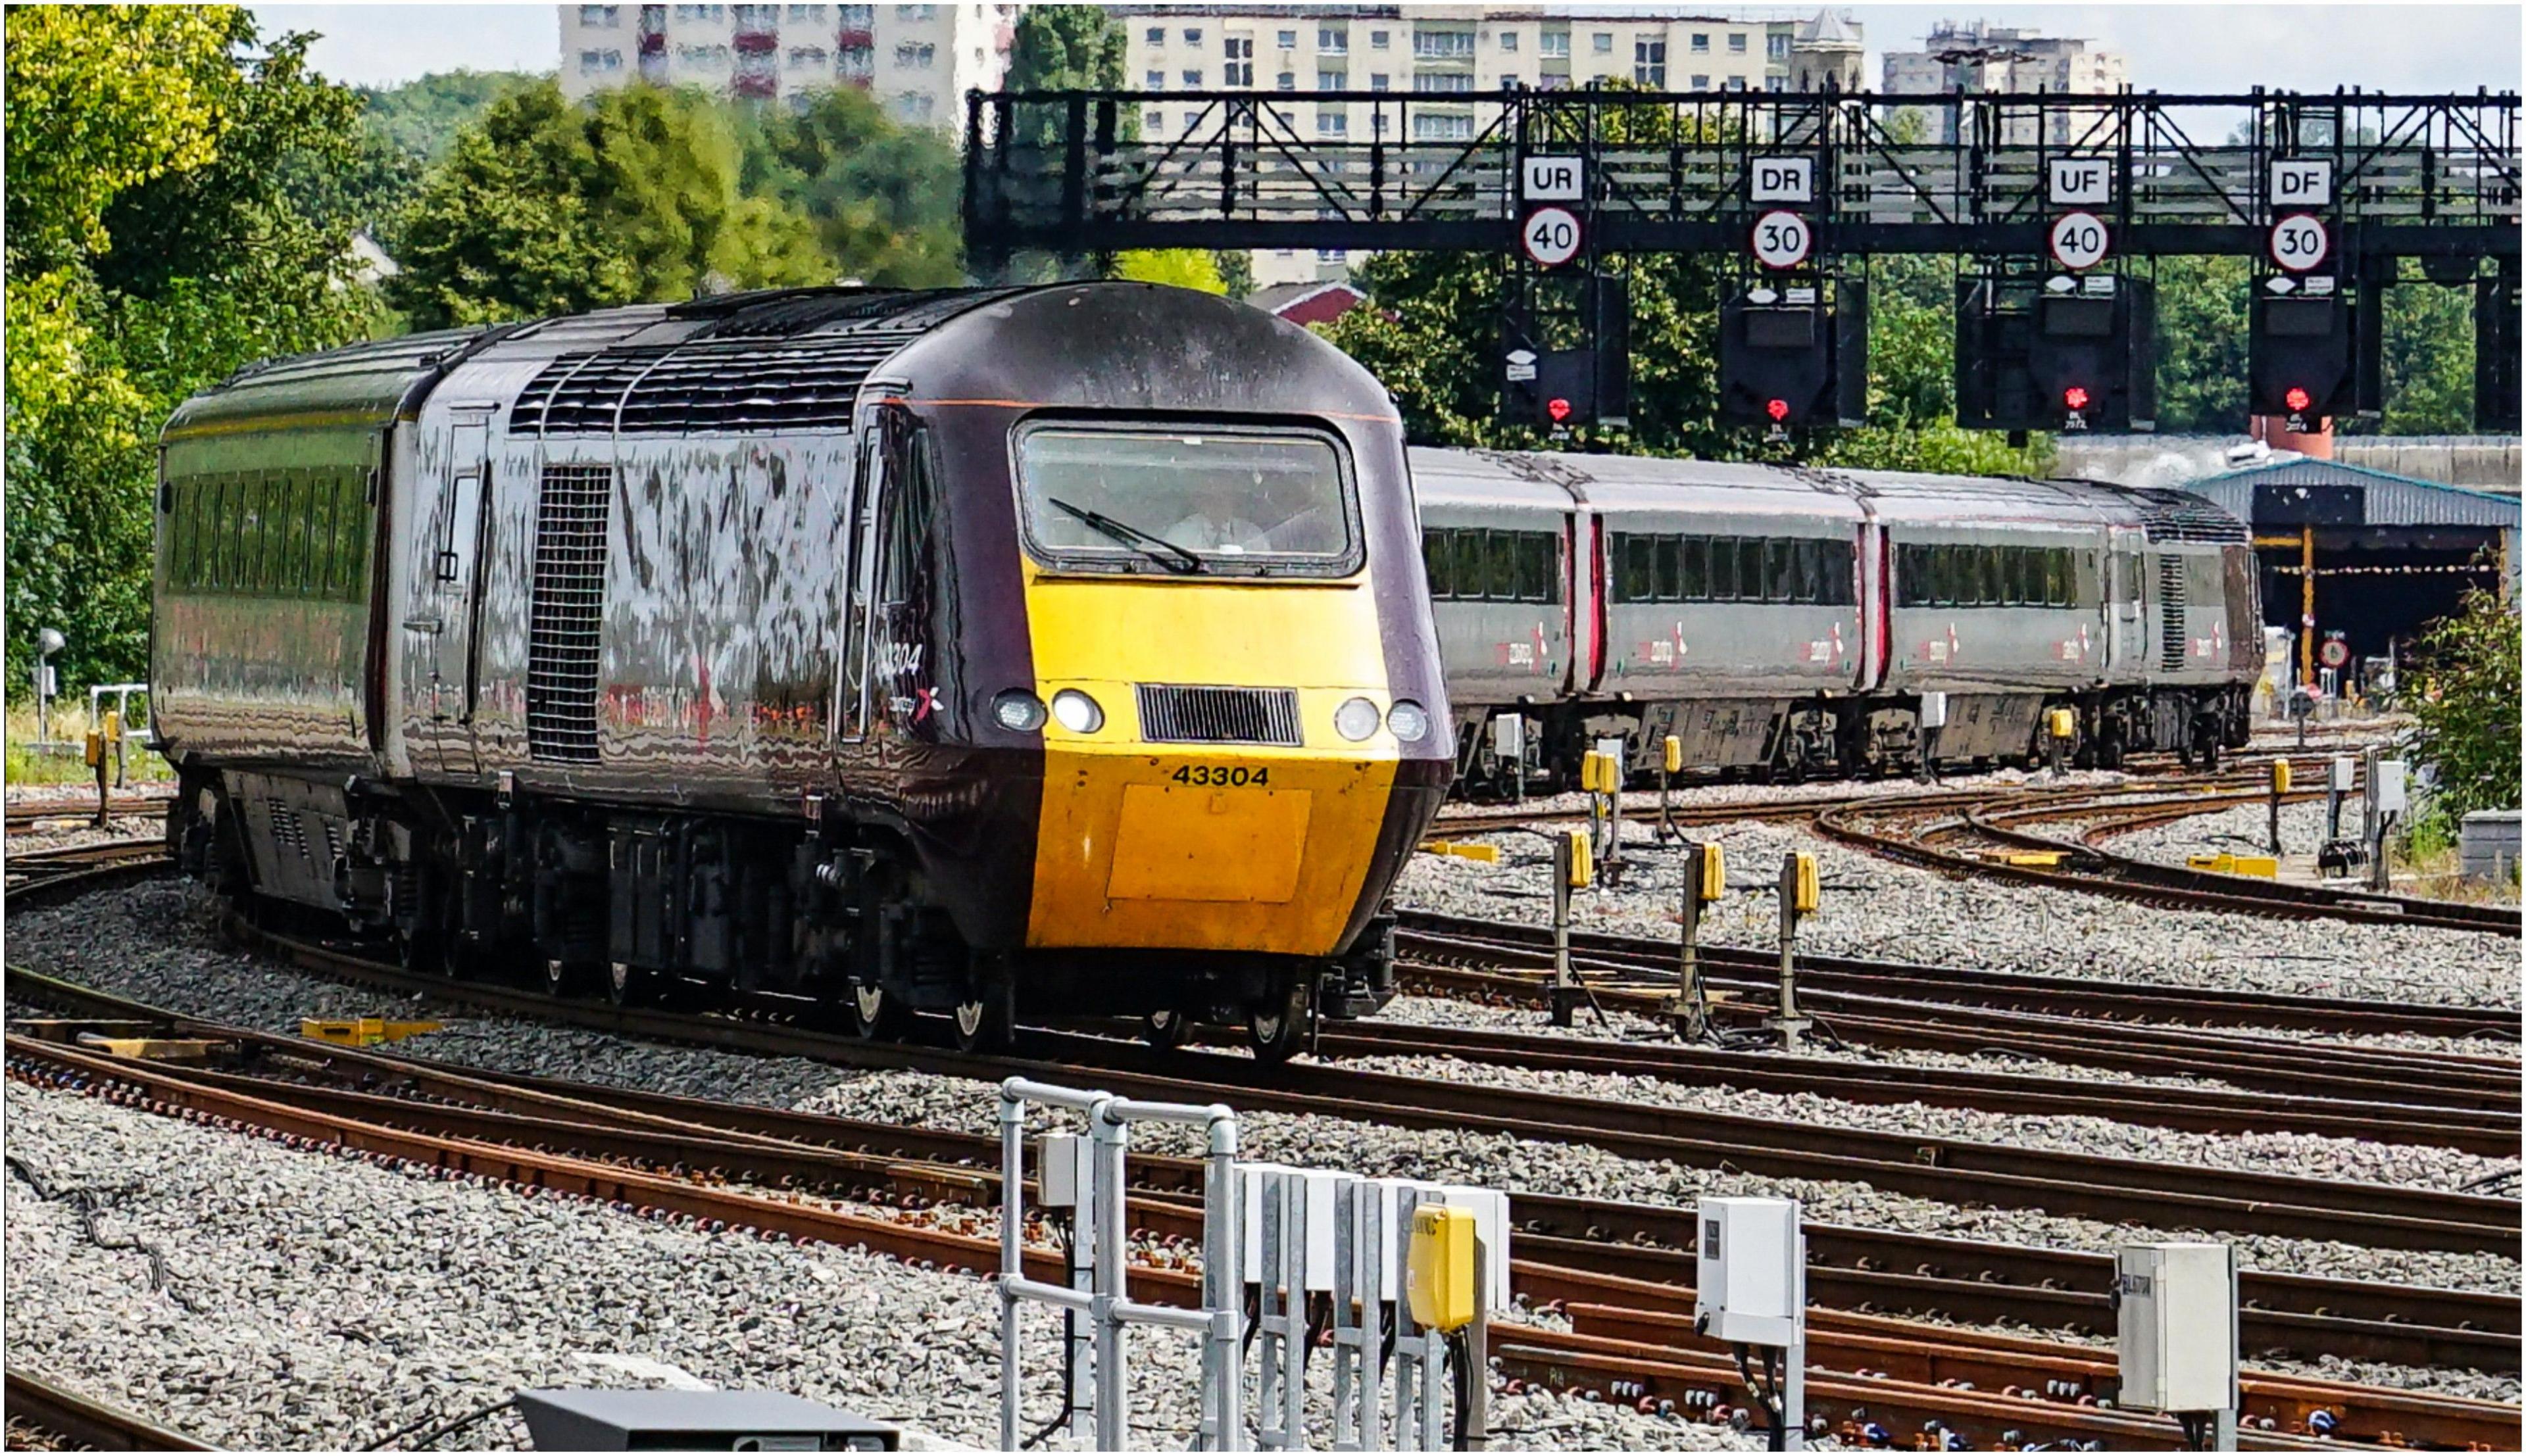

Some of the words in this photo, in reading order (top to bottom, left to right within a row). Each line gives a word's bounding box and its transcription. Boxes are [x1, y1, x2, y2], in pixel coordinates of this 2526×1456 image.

[1533, 166, 1572, 190] UR
[1762, 168, 1800, 191] DR
[2060, 170, 2098, 193] UF
[2281, 171, 2319, 195] DF
[1533, 222, 1572, 250] 40
[1762, 225, 1801, 254] 30
[2060, 228, 2100, 254] 40
[2281, 230, 2319, 256] 30
[1172, 764, 1270, 788] 43304
